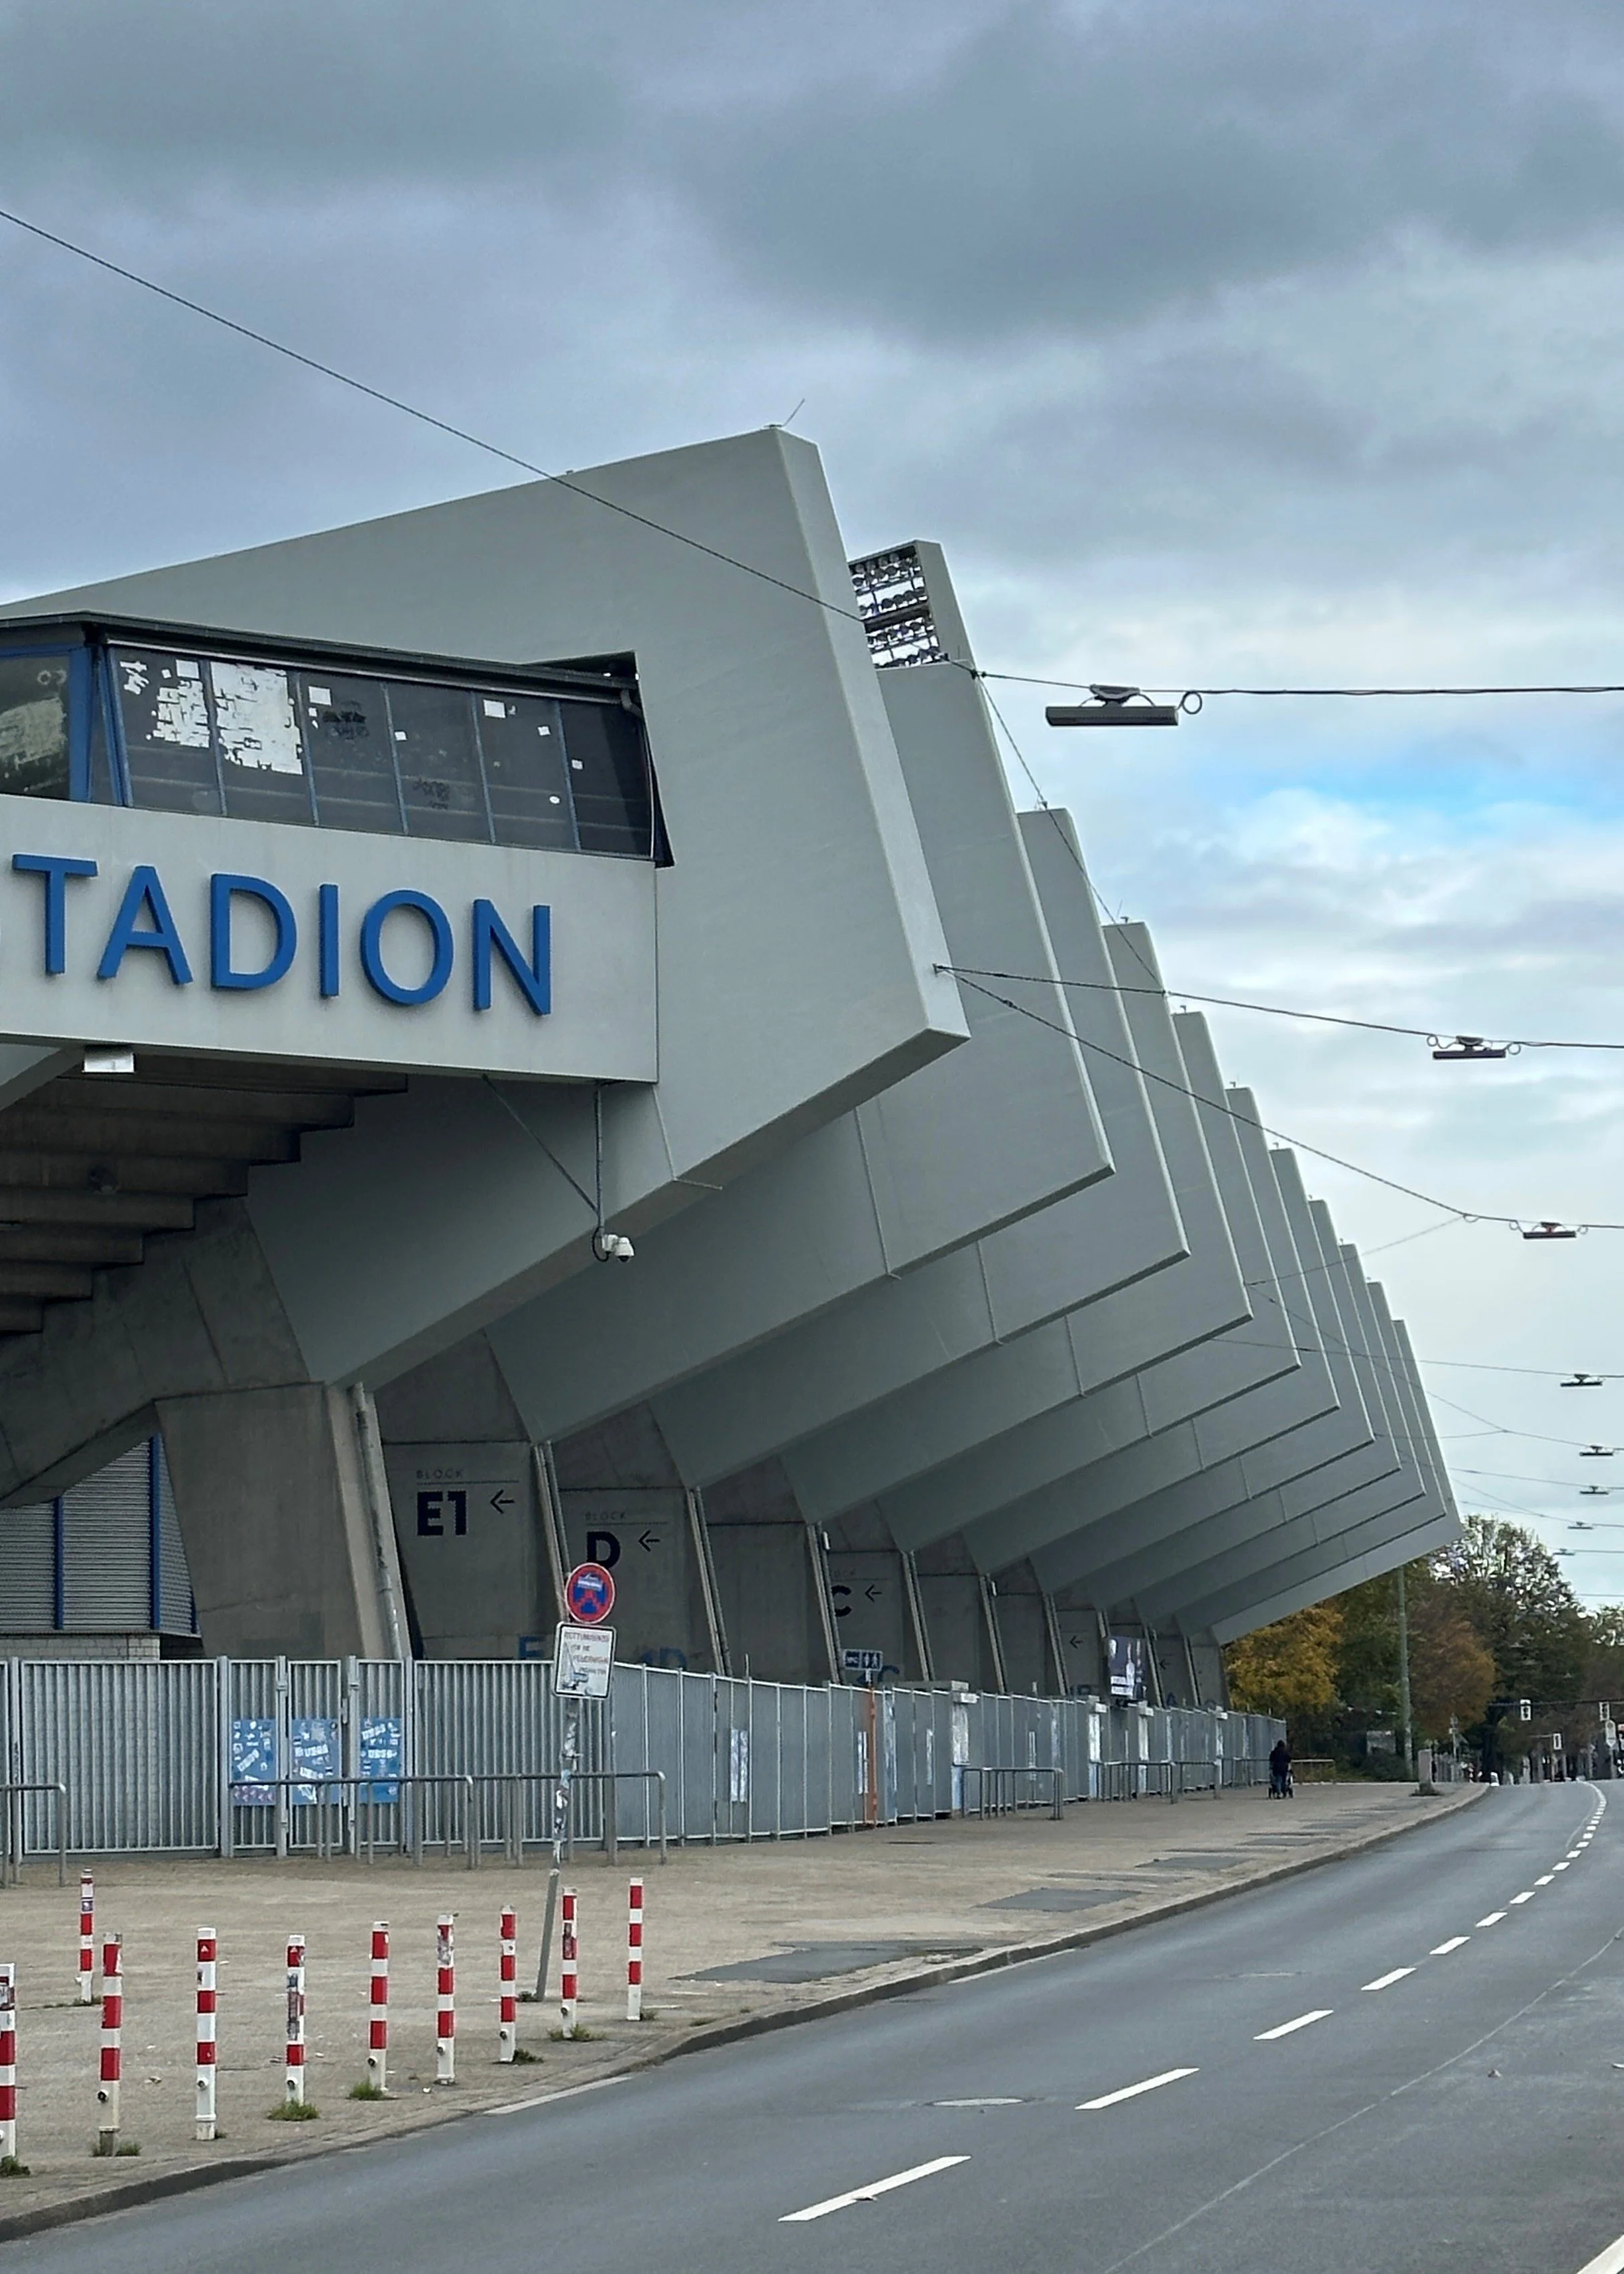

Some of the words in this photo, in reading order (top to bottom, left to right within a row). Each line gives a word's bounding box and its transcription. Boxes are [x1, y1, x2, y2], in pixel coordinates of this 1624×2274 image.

[11, 853, 552, 1015] TADION
[416, 1469, 464, 1479] BLOCK
[417, 1490, 467, 1536] E1
[585, 1510, 627, 1520] BLOCK
[586, 1531, 622, 1569] D
[831, 1585, 852, 1617] C
